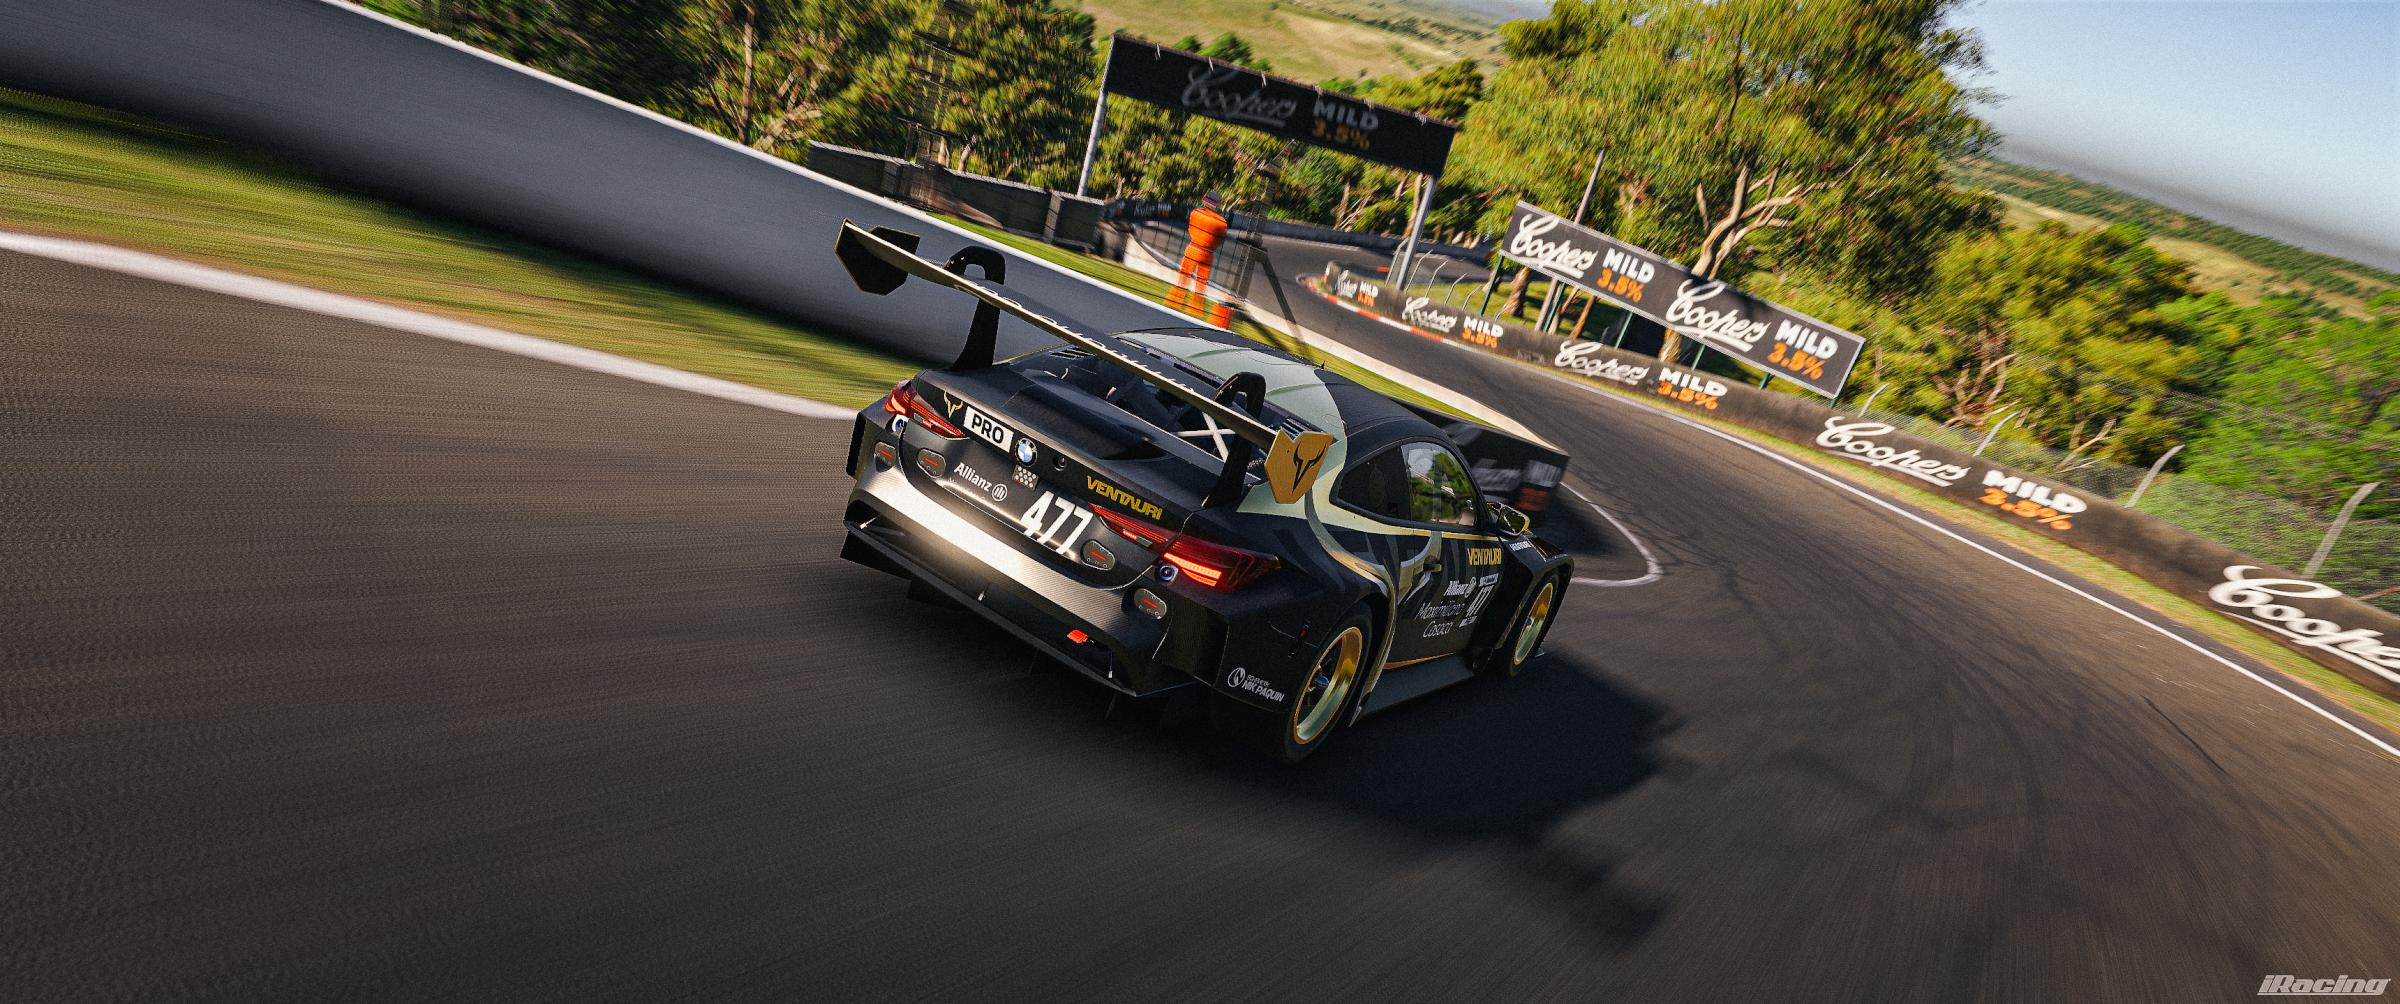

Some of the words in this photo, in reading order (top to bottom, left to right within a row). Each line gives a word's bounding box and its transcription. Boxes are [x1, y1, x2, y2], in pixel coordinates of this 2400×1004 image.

[1313, 99, 1379, 131] MILD
[1310, 119, 1371, 151] 3.5%
[1510, 213, 1598, 279] Coopers
[1602, 247, 1655, 284] MILD
[1596, 269, 1644, 302] 3.5%
[1463, 316, 1504, 338] MILD
[1665, 278, 1772, 353] Coopers
[1774, 320, 1838, 360] MILD
[1462, 327, 1498, 349] 3.5%
[1554, 339, 1650, 386] Coopers
[1658, 367, 1728, 398] MILD
[1766, 342, 1825, 381] 3.5%
[1655, 379, 1719, 410] 3.5%
[970, 413, 1005, 444] PRO
[953, 462, 993, 494] Allianz
[1815, 416, 1972, 488] Coopers
[1981, 469, 2087, 514] MILD
[1086, 474, 1164, 521] VENTAURI
[1977, 487, 2074, 531] 3.5%
[1020, 490, 1094, 555] 477
[1254, 686, 1285, 702] PAQUIN
